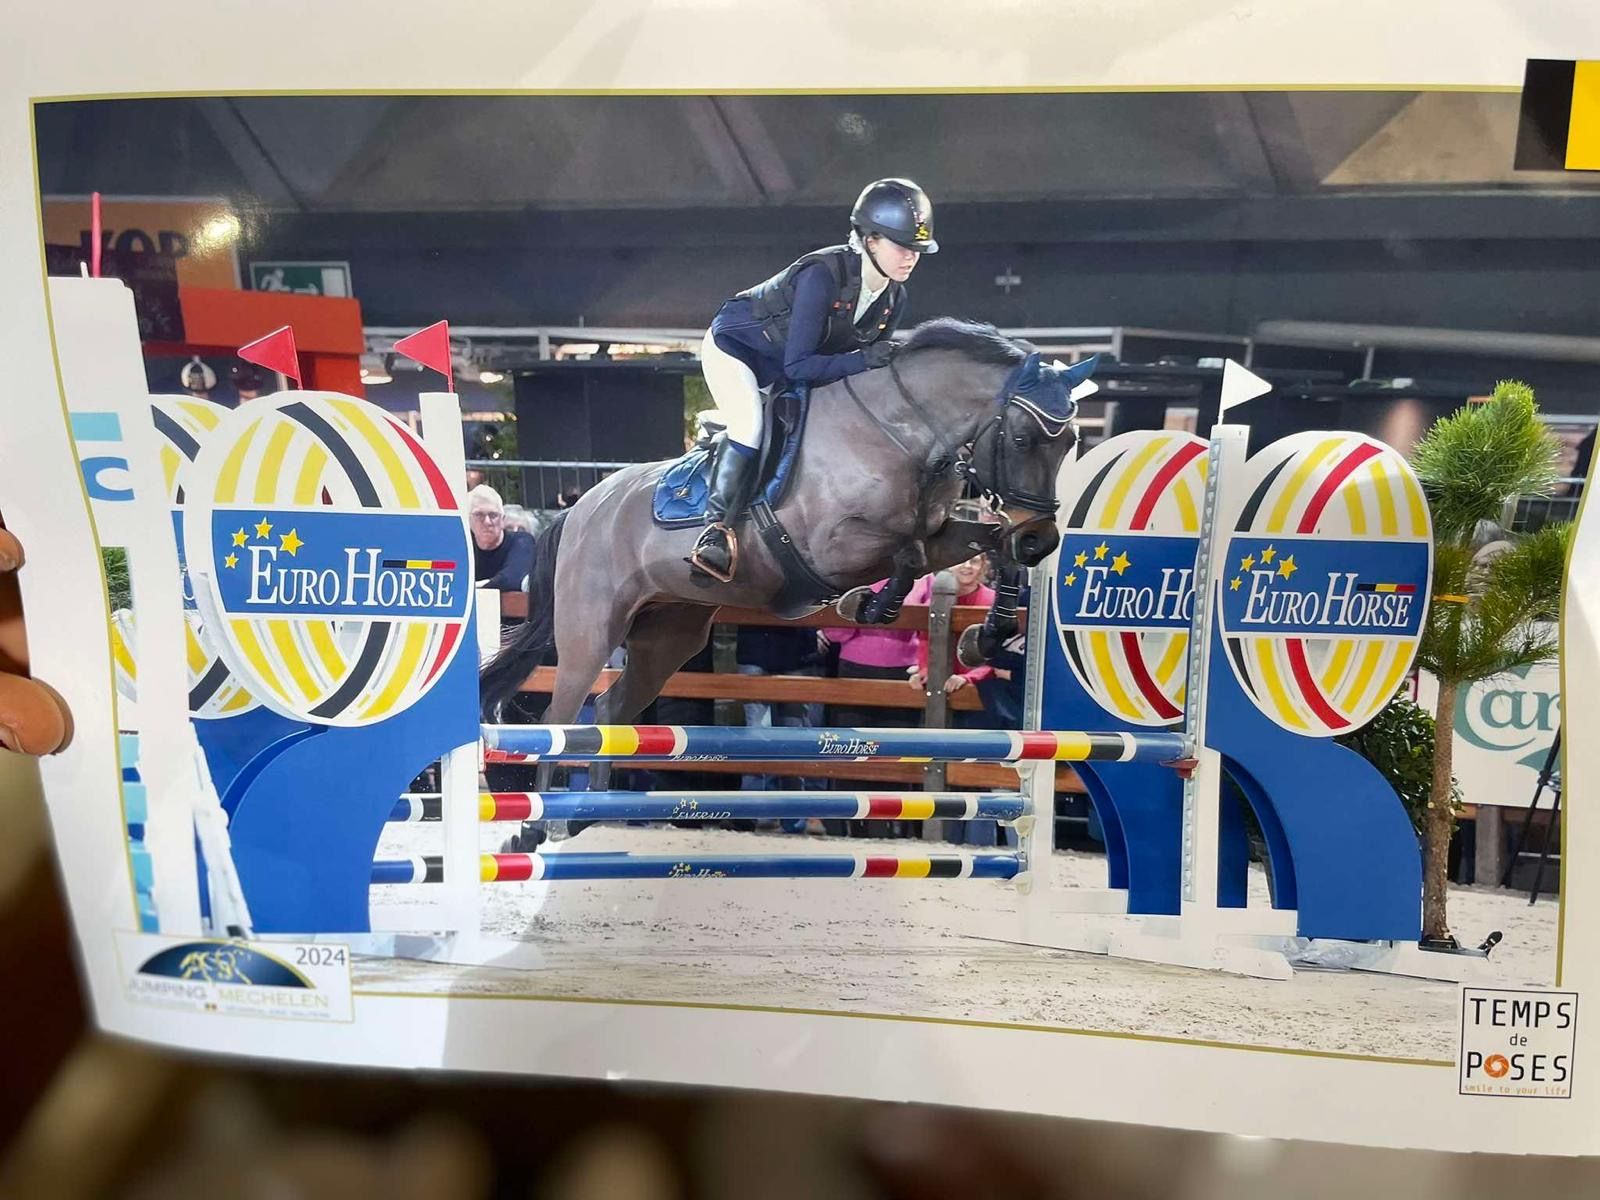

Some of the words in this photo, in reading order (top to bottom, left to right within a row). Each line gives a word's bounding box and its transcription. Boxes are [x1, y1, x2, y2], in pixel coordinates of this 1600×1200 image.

[295, 947, 346, 967] 2024
[218, 988, 330, 1008] MECHELEN
[1469, 997, 1571, 1029] TEMPS
[1509, 1033, 1528, 1046] de
[1466, 1051, 1568, 1082] POSES
[1464, 1084, 1493, 1093] smile
[1499, 1085, 1511, 1094] to
[1516, 1086, 1538, 1095] your
[1544, 1086, 1567, 1095] life
